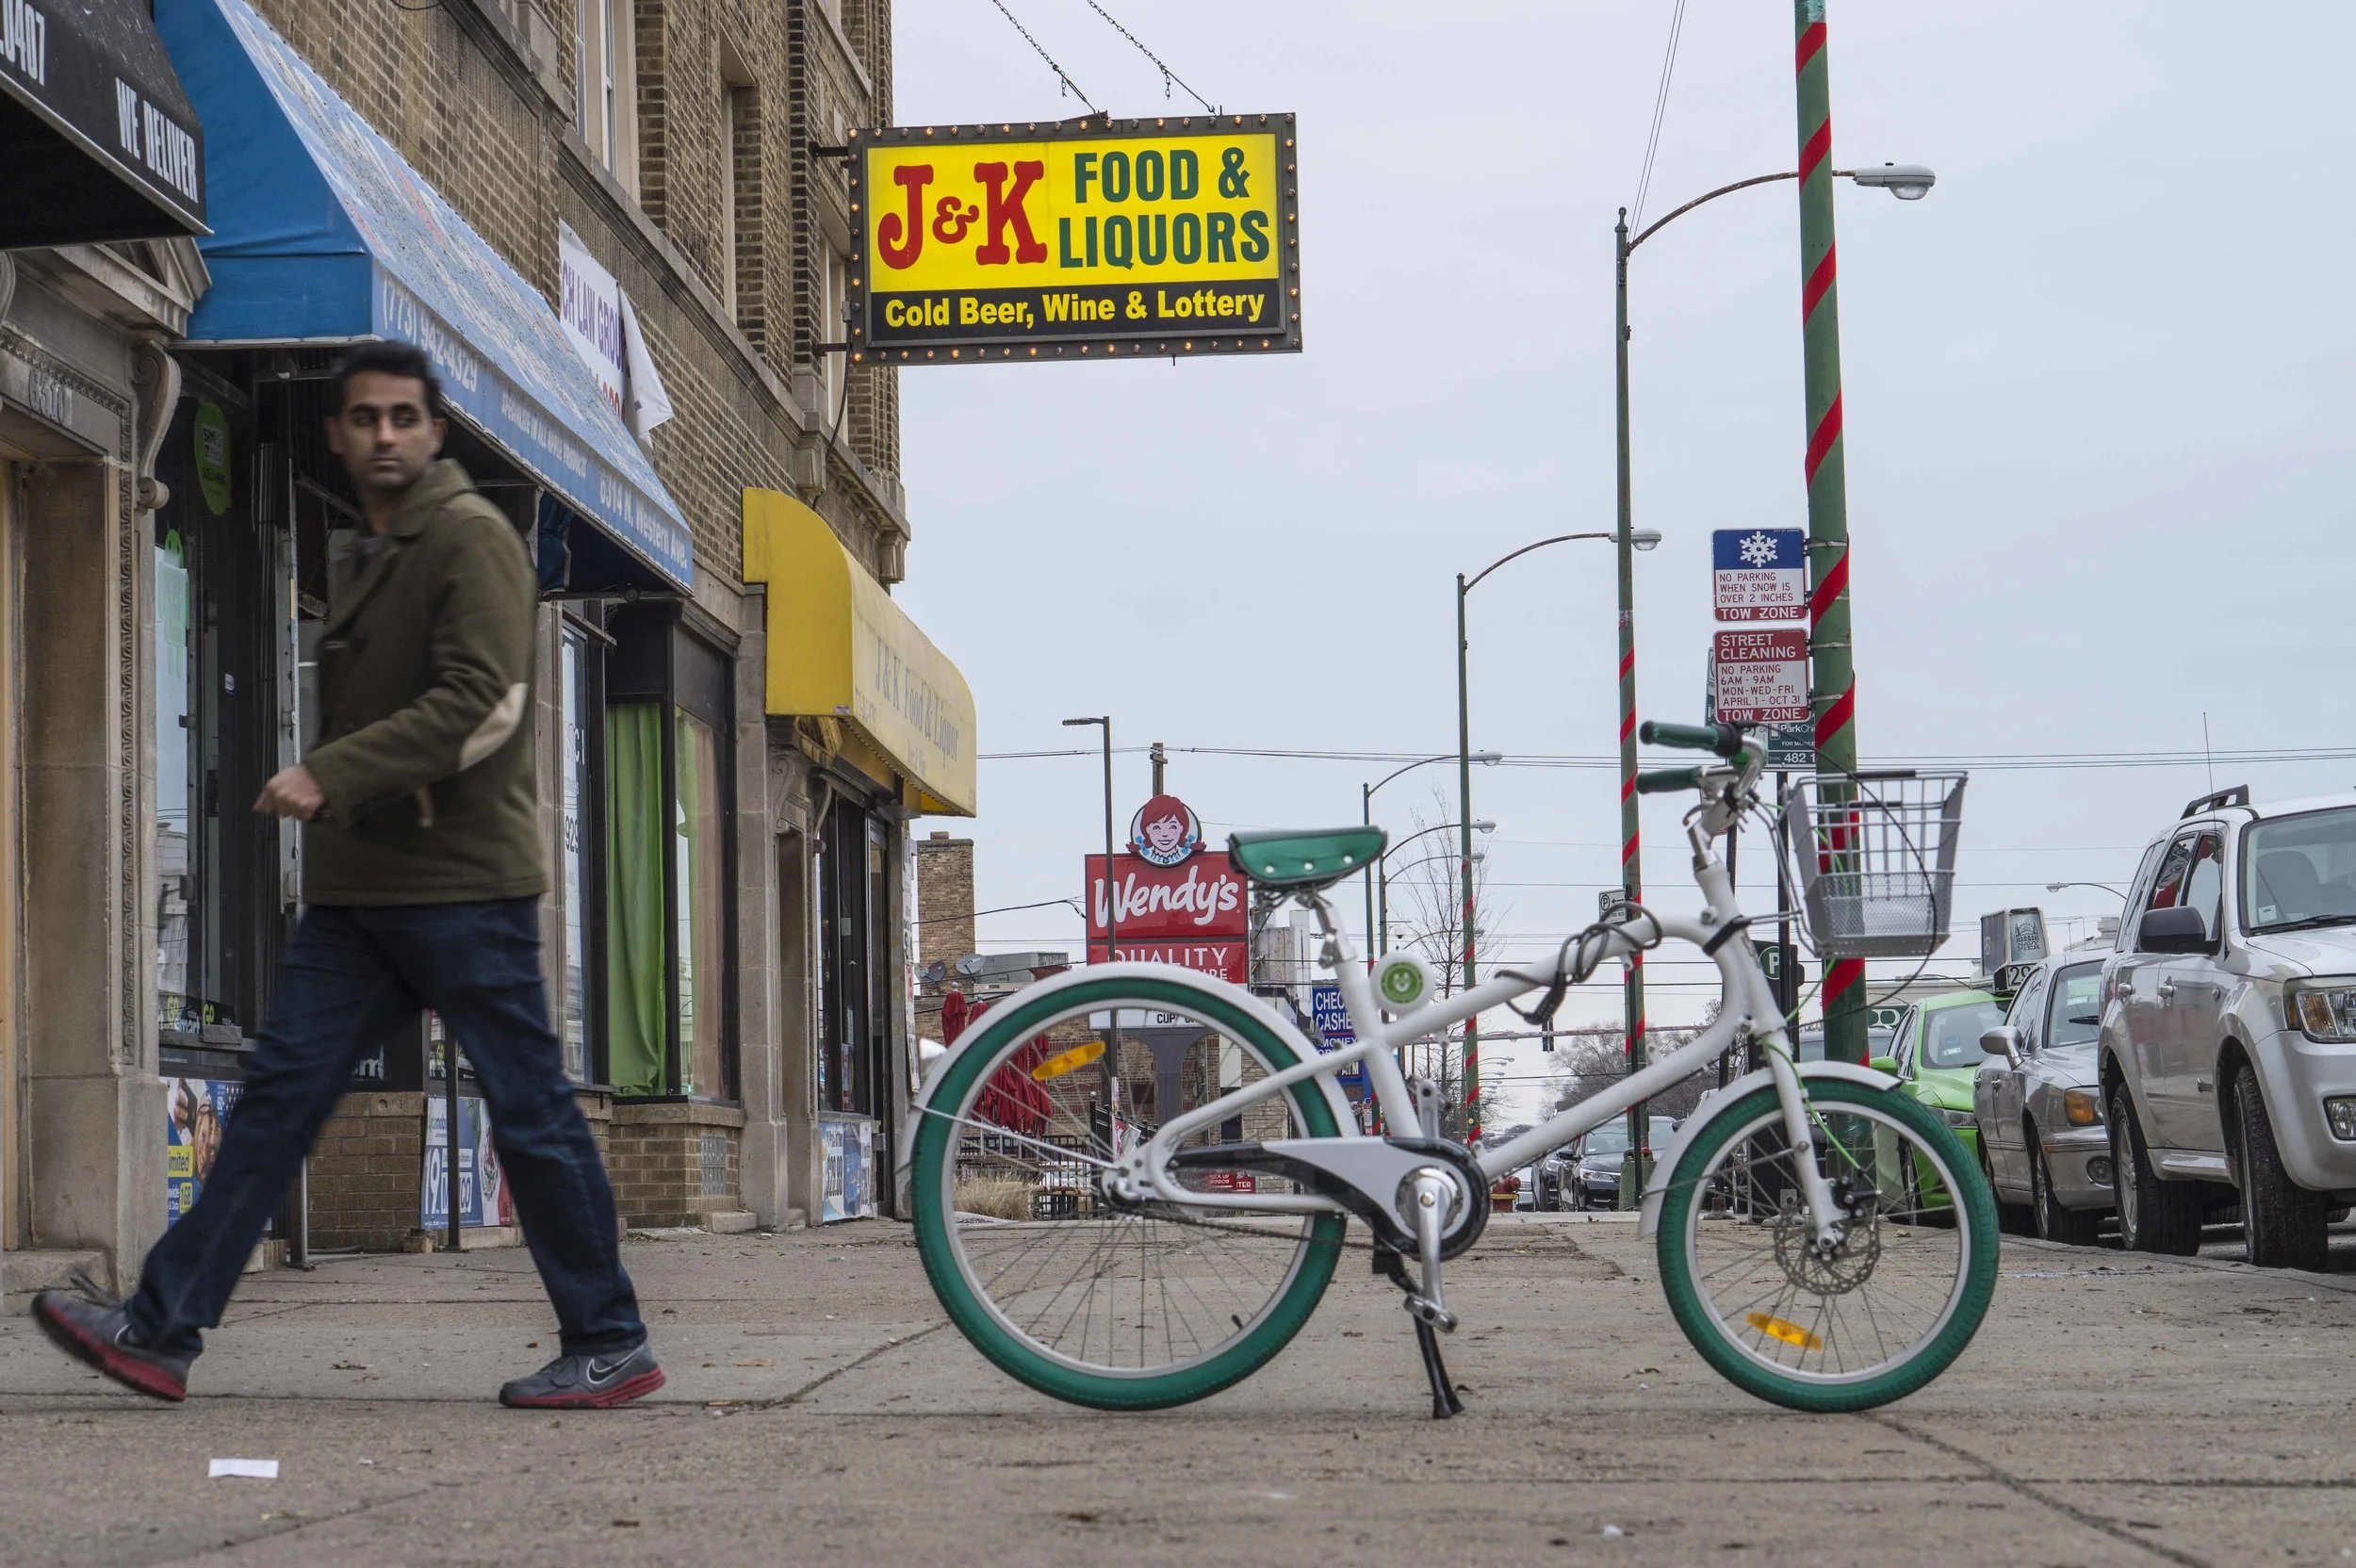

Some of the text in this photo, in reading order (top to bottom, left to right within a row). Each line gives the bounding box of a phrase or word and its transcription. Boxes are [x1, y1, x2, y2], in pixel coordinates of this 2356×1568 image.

[116, 76, 198, 204] WE DELIVER
[1073, 146, 1251, 204] FOOD &
[877, 160, 1048, 270] J&K
[1058, 209, 1269, 270] LIQUORS
[559, 260, 576, 327] CH
[578, 274, 596, 345] LAW
[885, 288, 1266, 330] Cold Beer, Wine & Lottery
[599, 471, 688, 569] 6314 N. Western Ave.
[1719, 572, 1776, 582] NO PARKING
[1720, 581, 1791, 593] WHEN SNOW IS
[1720, 593, 1794, 603] OVER 2 INCHES
[1721, 607, 1799, 620] TOW ZONE
[1721, 634, 1774, 646] STREET
[1720, 646, 1796, 661] CLEANING
[1721, 664, 1781, 675] NO PARKING
[1721, 676, 1743, 685] 6AM
[1753, 675, 1775, 684] 9AM
[1722, 685, 1794, 695] MON-WED-FRI
[875, 637, 882, 691] J
[883, 645, 891, 701] &
[892, 656, 901, 711] K
[904, 665, 926, 733] Food
[925, 688, 933, 742] &
[933, 695, 960, 768] Liquor
[1723, 696, 1752, 706] APRIL
[1755, 696, 1759, 706] 1
[1769, 695, 1789, 705] OCT
[1791, 695, 1801, 705] 31
[1723, 709, 1801, 722] TOW ZONE
[1784, 753, 1807, 763] 482
[1094, 865, 1239, 927] Wendy's
[1768, 952, 1780, 974] P
[1316, 991, 1345, 1011] CHEC
[1156, 1013, 1176, 1024] CUP
[1316, 1012, 1353, 1031] CASHE
[1341, 1061, 1360, 1075] ATM
